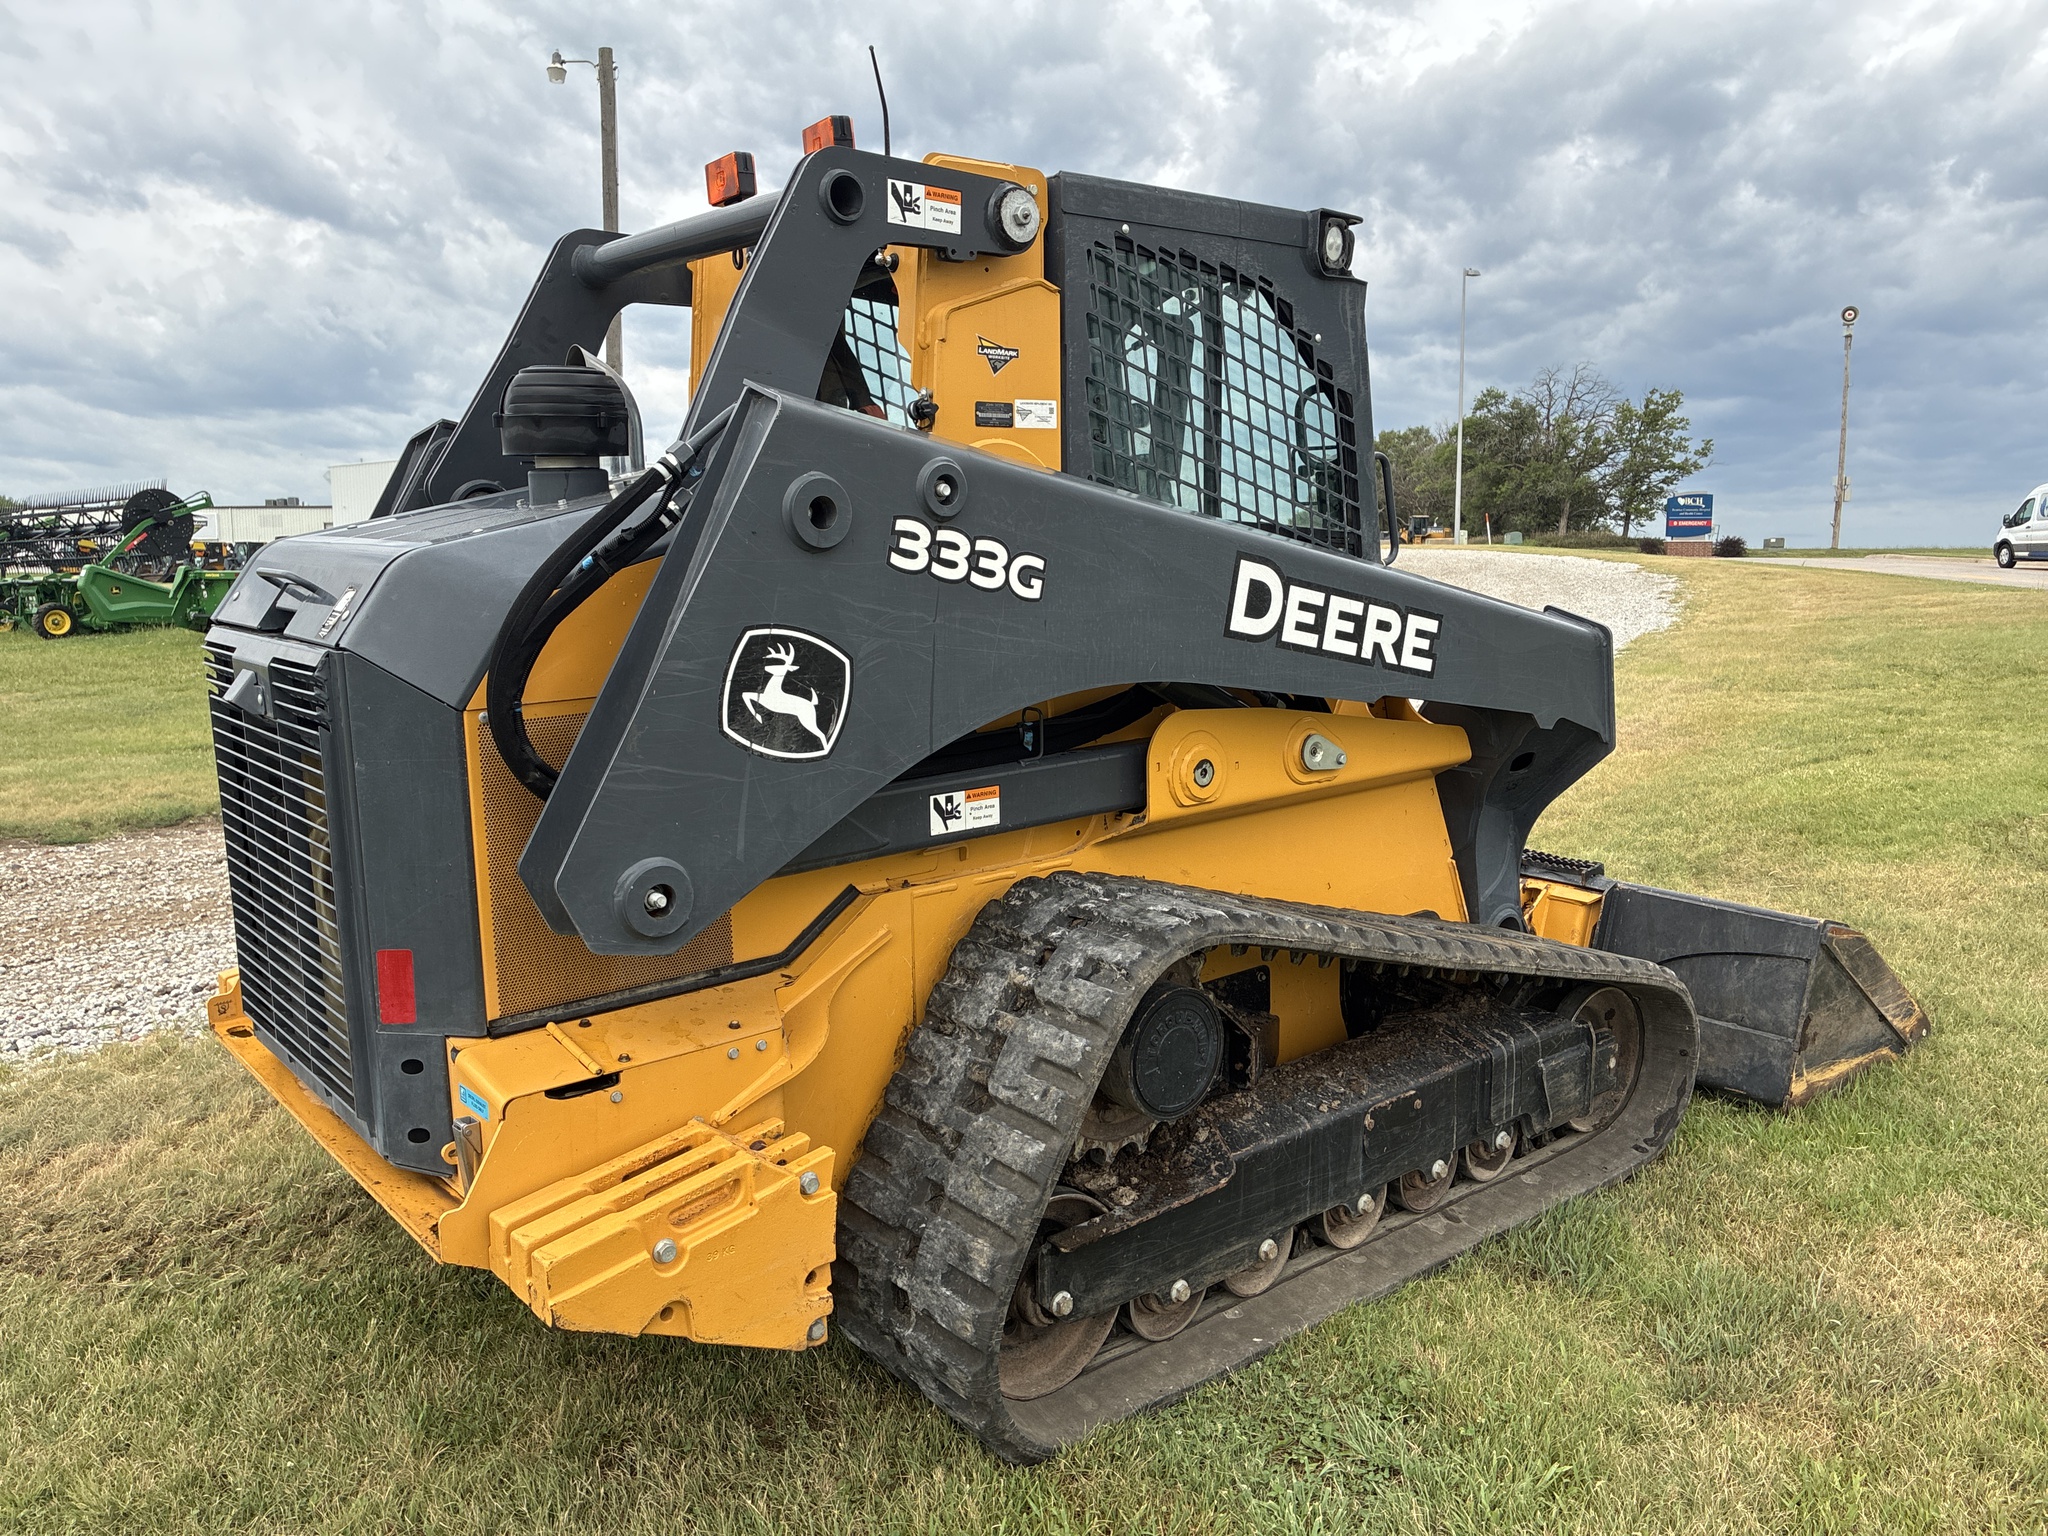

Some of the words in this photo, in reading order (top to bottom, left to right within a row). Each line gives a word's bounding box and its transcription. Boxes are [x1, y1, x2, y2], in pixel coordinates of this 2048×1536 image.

[932, 191, 958, 201] WARNING
[930, 205, 944, 213] Pinch
[1685, 497, 1703, 505] BCH
[890, 519, 1045, 599] 333G
[1230, 559, 1439, 672] DEERE
[972, 790, 996, 798] WARNING
